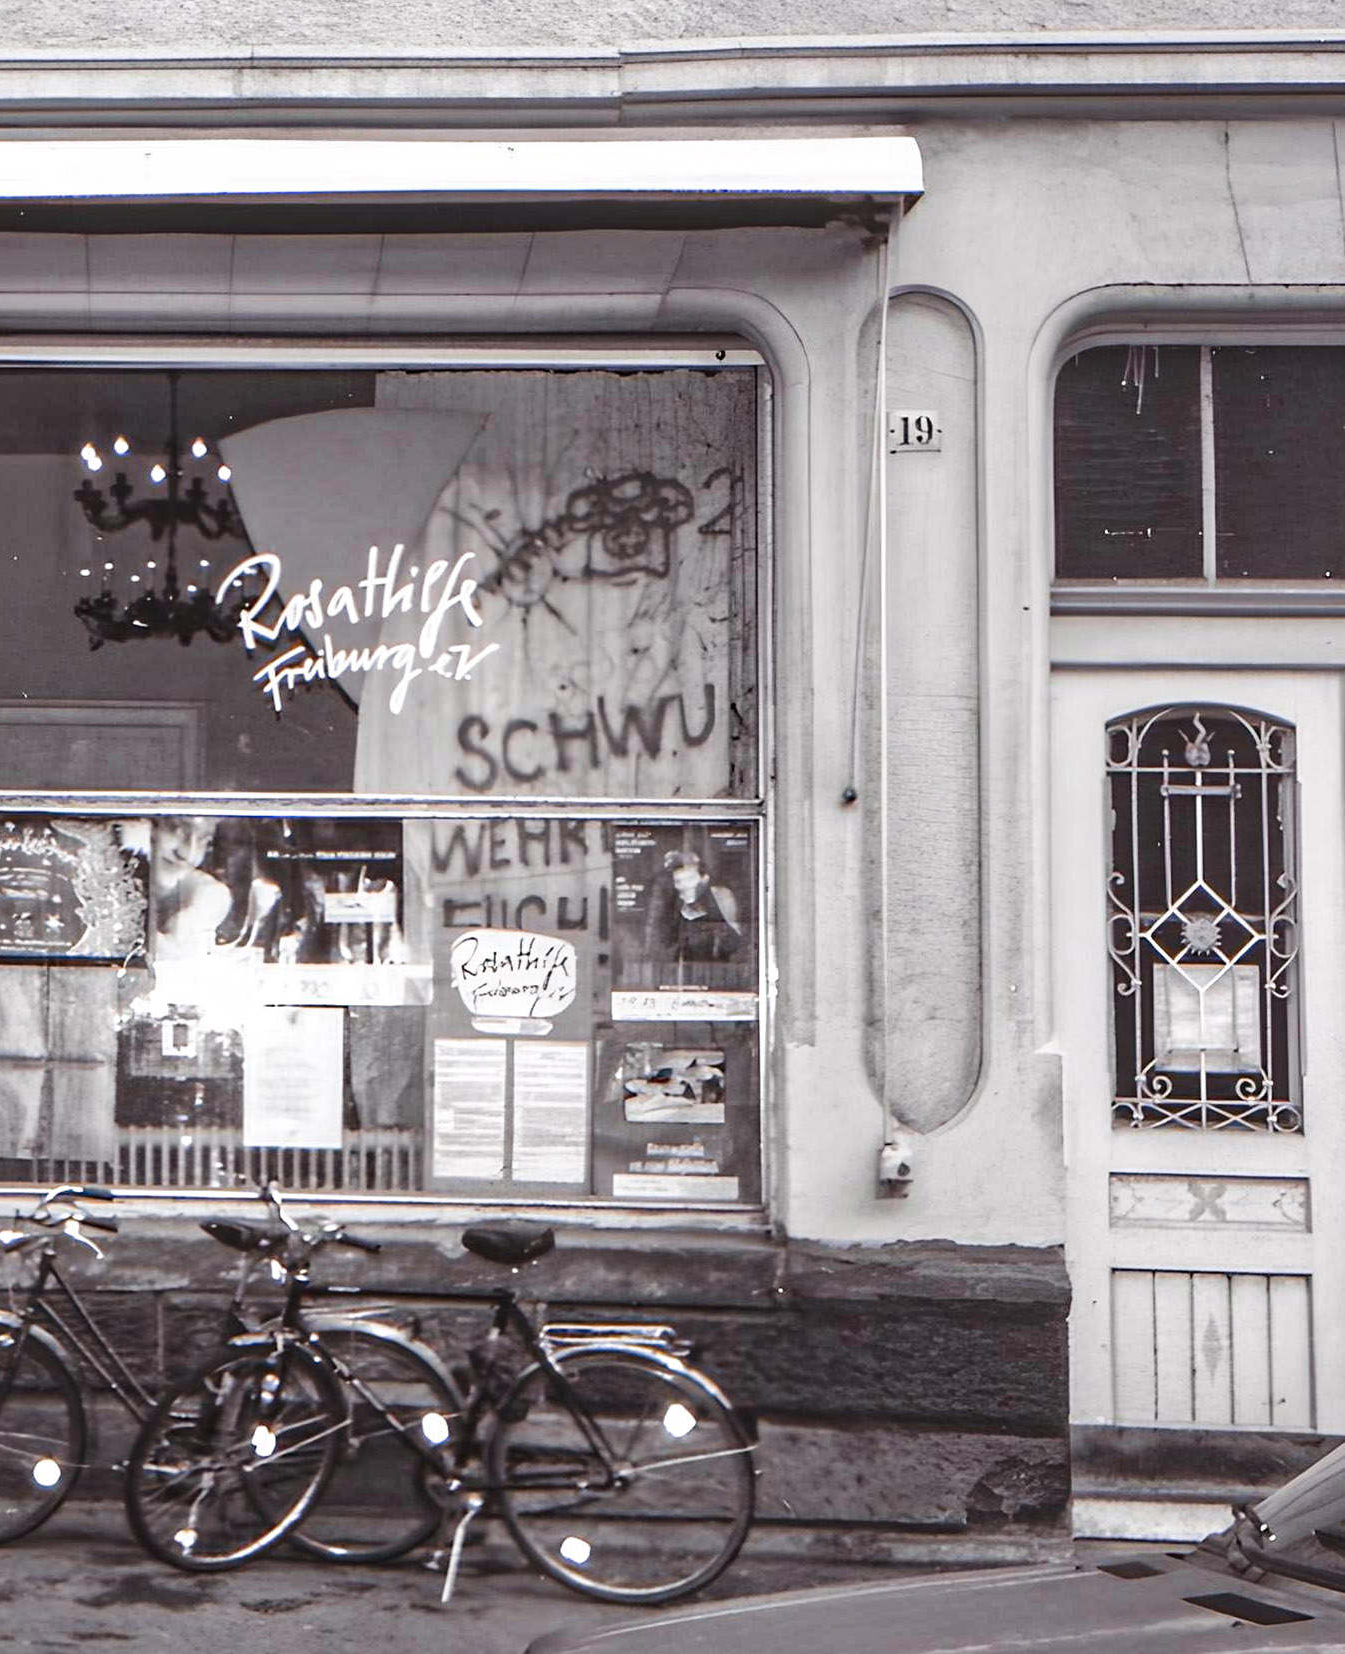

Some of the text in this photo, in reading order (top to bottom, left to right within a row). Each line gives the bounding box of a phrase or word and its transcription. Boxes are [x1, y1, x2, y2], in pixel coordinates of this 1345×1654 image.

[896, 415, 933, 446] 19
[253, 634, 423, 715] Freiburg
[455, 683, 716, 792] SCHWU
